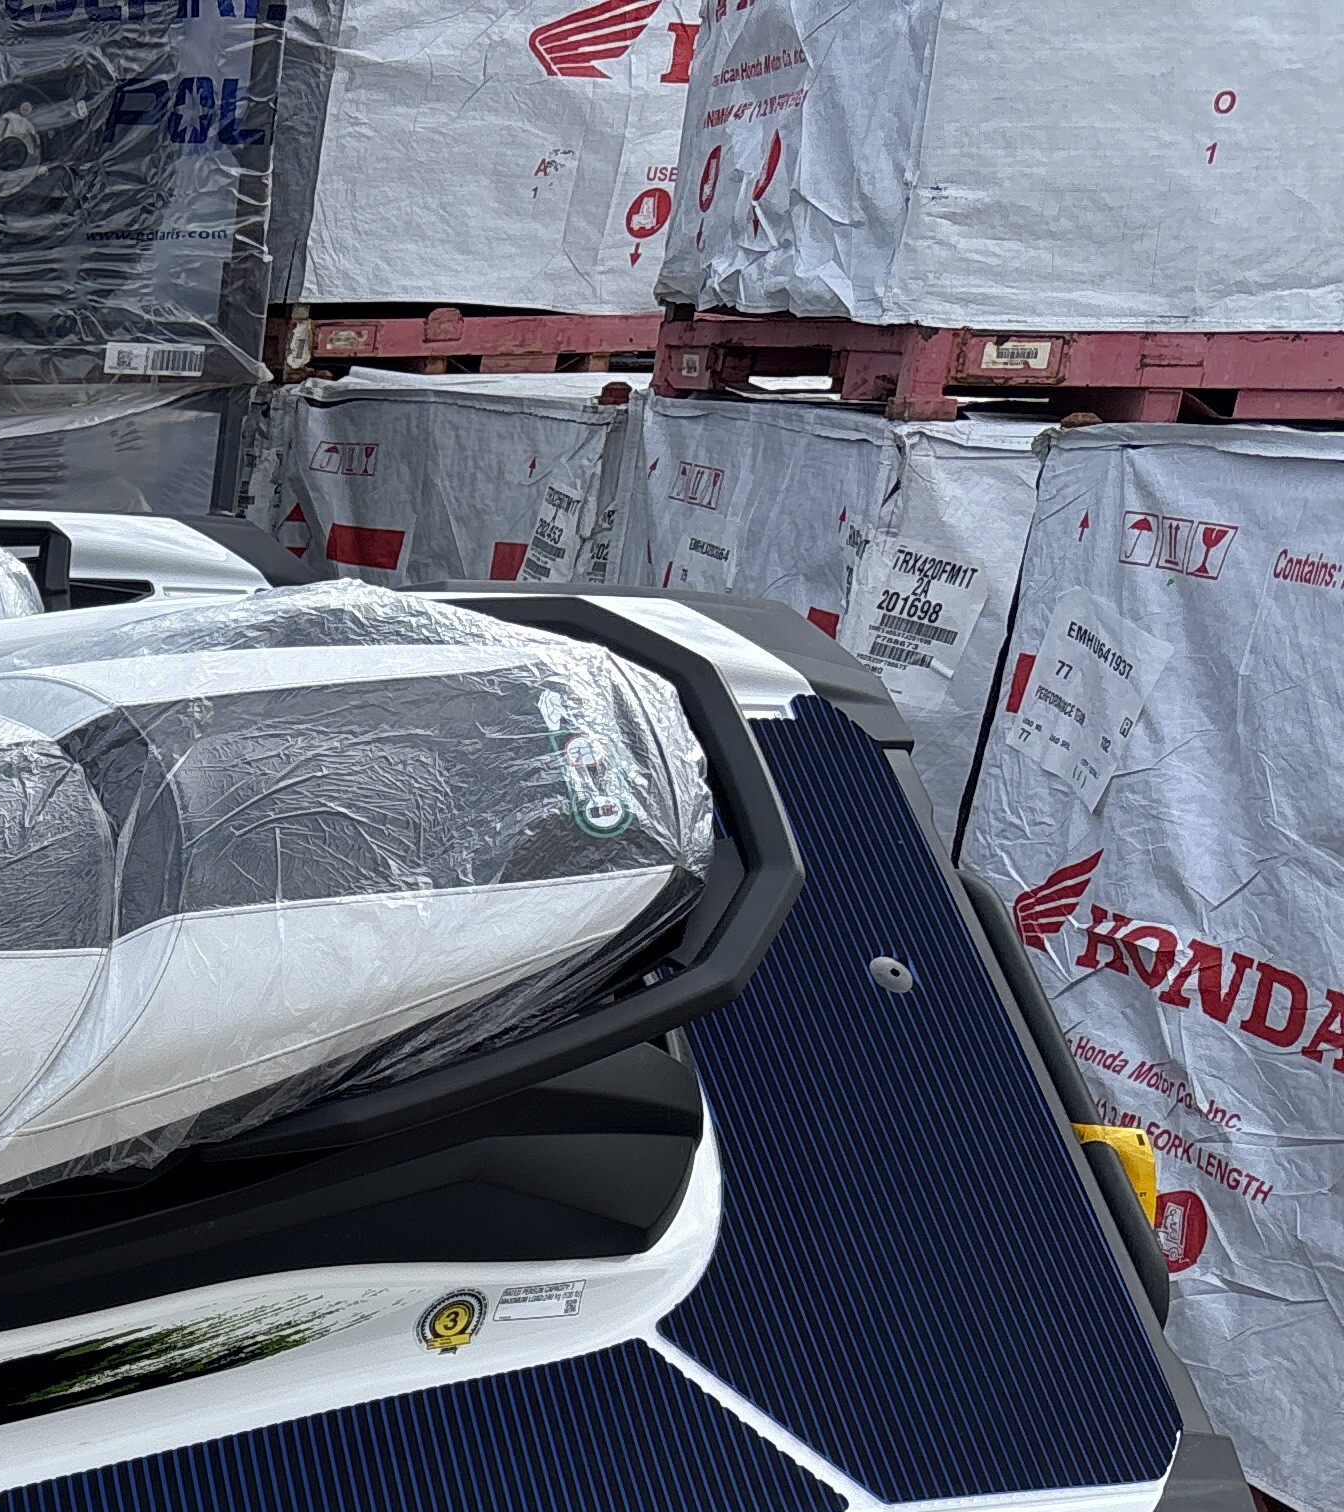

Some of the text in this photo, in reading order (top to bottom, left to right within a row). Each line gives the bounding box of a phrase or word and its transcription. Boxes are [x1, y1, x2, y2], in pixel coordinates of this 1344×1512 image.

[1273, 547, 1343, 589] Contains:
[876, 589, 943, 624] 201698
[1055, 659, 1074, 680] 77
[1018, 727, 1032, 743] 77
[1073, 1034, 1130, 1076] Honda
[1127, 1060, 1175, 1099] Motor
[1204, 1098, 1244, 1133] Inc.
[1145, 1120, 1194, 1165] FORK
[1196, 1146, 1274, 1206] LENGTH
[442, 1310, 460, 1332] 3
